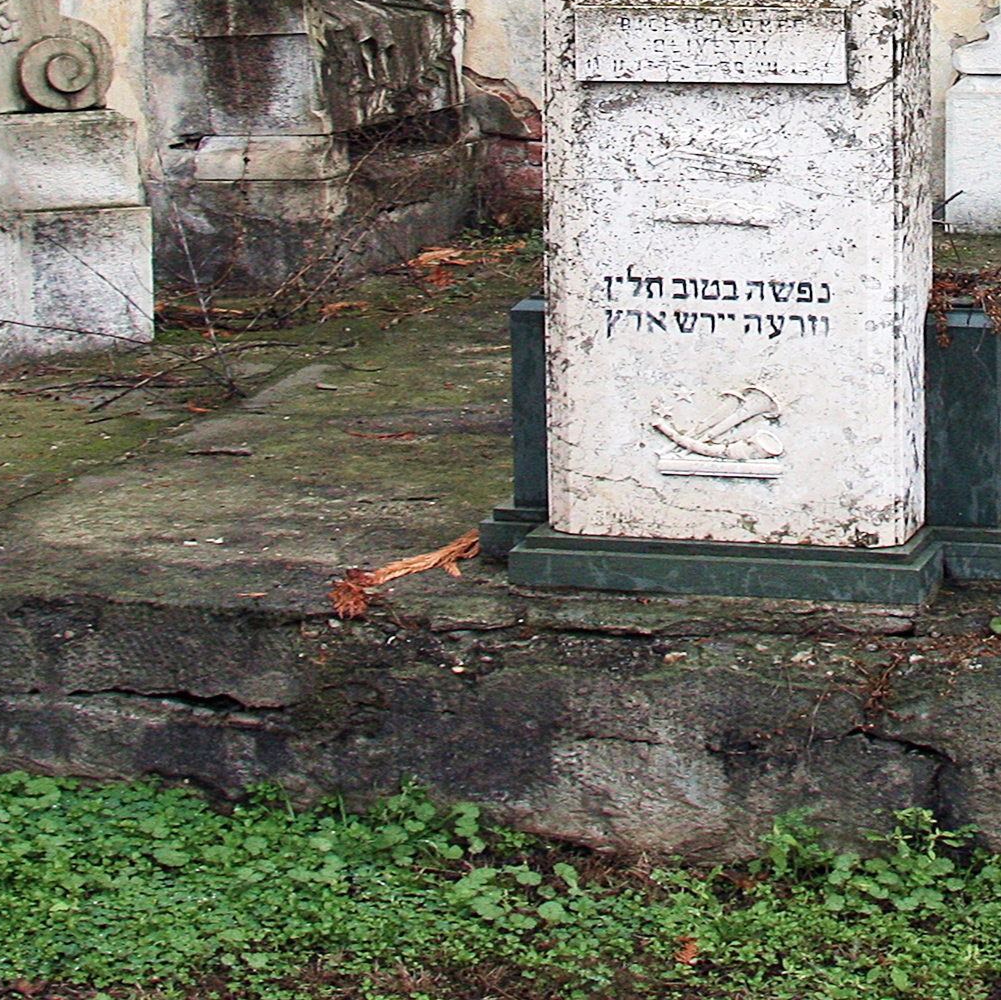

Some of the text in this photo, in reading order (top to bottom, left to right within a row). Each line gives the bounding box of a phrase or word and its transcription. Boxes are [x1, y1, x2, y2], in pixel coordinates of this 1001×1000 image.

[604, 264, 832, 304] נפשה בטוב תלין
[605, 309, 829, 339] וזרעה יירש ארץ
